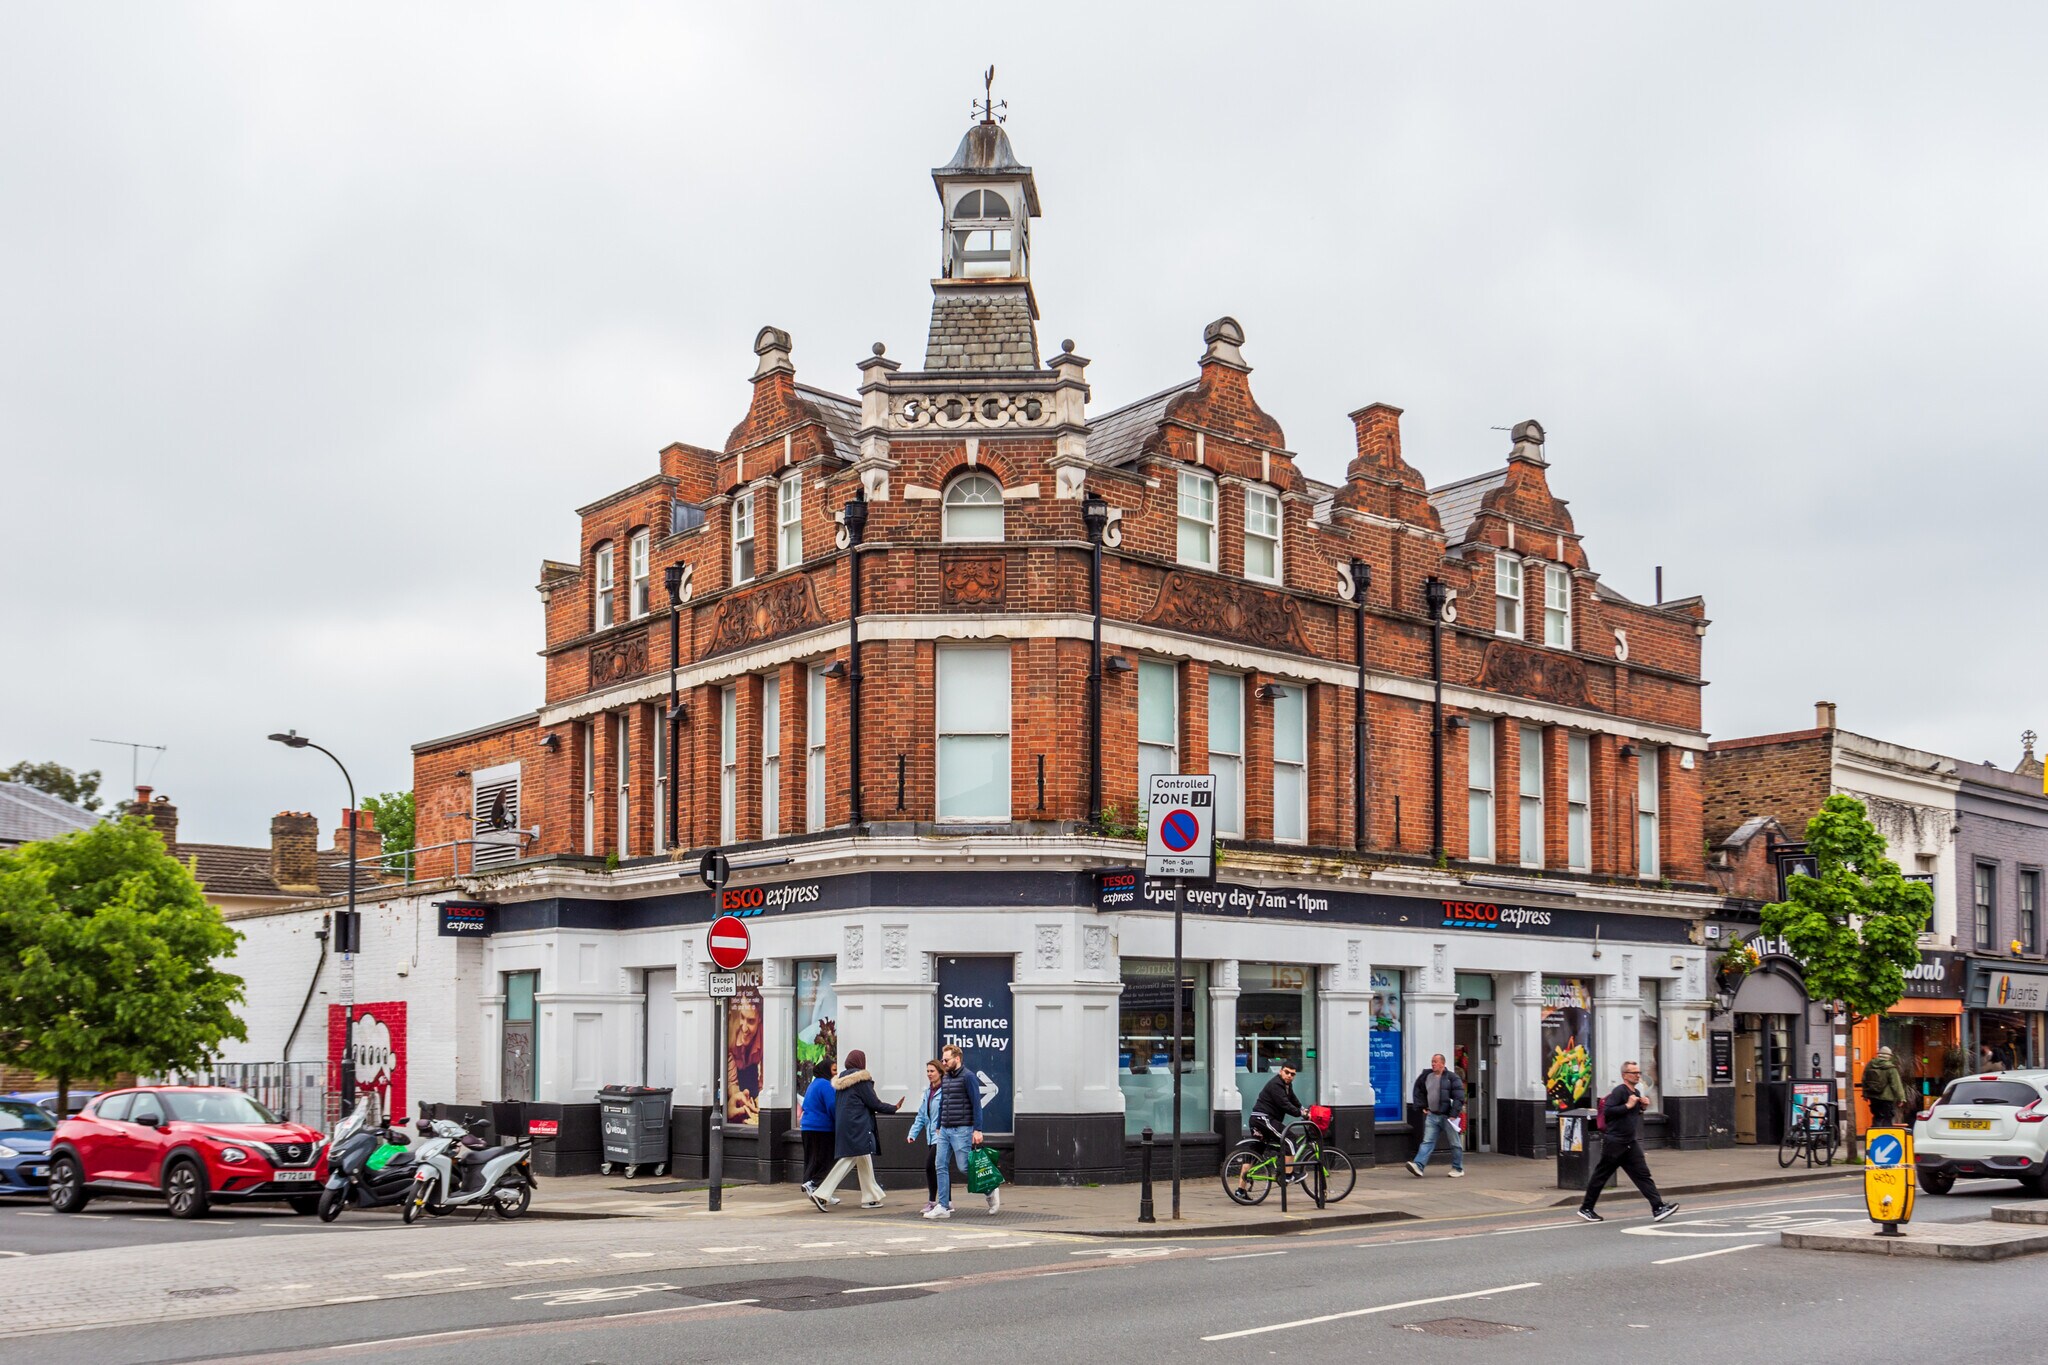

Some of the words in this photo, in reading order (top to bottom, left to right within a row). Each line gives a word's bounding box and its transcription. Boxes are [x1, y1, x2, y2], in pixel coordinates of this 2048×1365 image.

[1156, 780, 1209, 788] Controlled
[1152, 794, 1188, 804] ZONE
[1194, 793, 1207, 805] JJ
[1103, 875, 1135, 887] TESCO
[711, 888, 764, 909] ESCO
[766, 885, 819, 911] express
[1103, 892, 1134, 905] express
[1186, 889, 1226, 908] every
[1229, 888, 1255, 910] day
[1258, 891, 1287, 908] 7am
[445, 907, 485, 917] TESCO
[1442, 901, 1498, 920] TESCO
[1500, 908, 1551, 929] express
[447, 921, 484, 932] express
[712, 976, 734, 984] Except
[736, 972, 759, 986] HOICE
[802, 968, 824, 981] EASY
[1371, 972, 1391, 986] ello.
[1541, 985, 1580, 996] SSIONATE
[944, 994, 983, 1008] Store
[1542, 997, 1559, 1008] OUT
[1560, 997, 1582, 1008] FOOD
[944, 1015, 1008, 1029] Entrance
[943, 1034, 973, 1048] This
[976, 1034, 1009, 1051] Way
[1951, 1120, 1971, 1129] YT66
